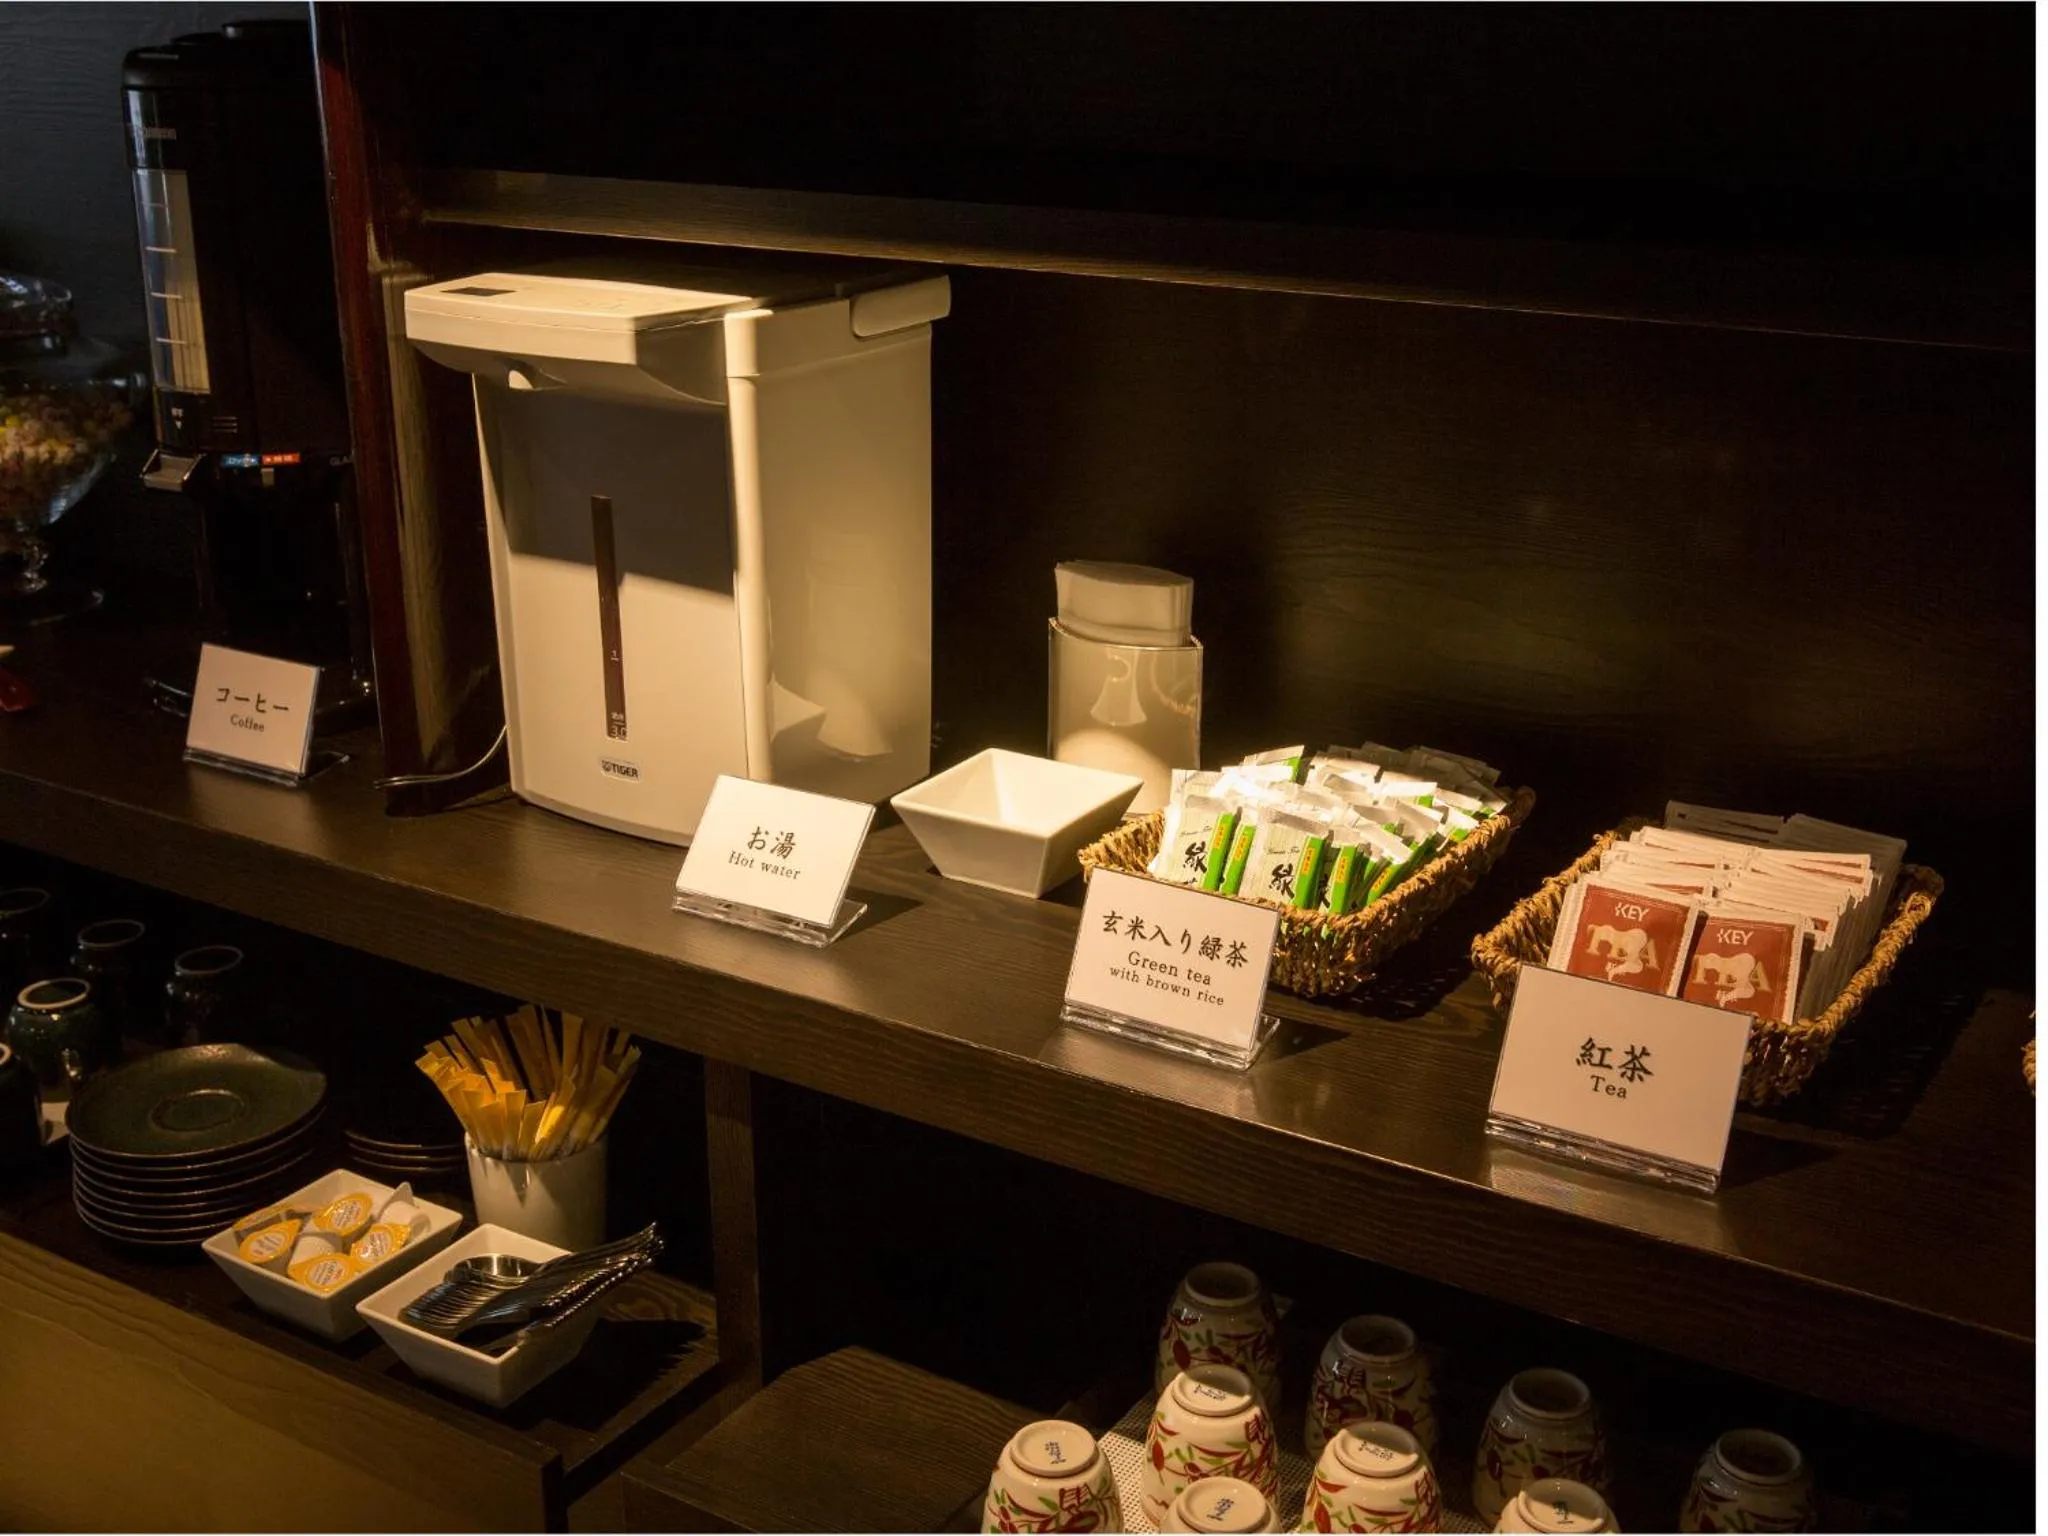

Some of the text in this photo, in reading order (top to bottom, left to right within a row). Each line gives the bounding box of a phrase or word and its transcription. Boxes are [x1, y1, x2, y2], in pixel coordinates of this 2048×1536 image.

[216, 687, 289, 713] コーヒー
[230, 713, 265, 732] Coffee
[611, 762, 639, 778] TIGER
[747, 826, 796, 859] お湯
[728, 850, 801, 880] Hot water
[1615, 902, 1650, 921] KEY
[1102, 910, 1248, 969] 玄米入り緑茶
[1717, 928, 1754, 946] KEY
[1127, 951, 1211, 986] Green tea
[1109, 965, 1224, 1006] with brown rice
[1576, 1037, 1654, 1082] 紅茶
[1590, 1074, 1627, 1098] Tea
